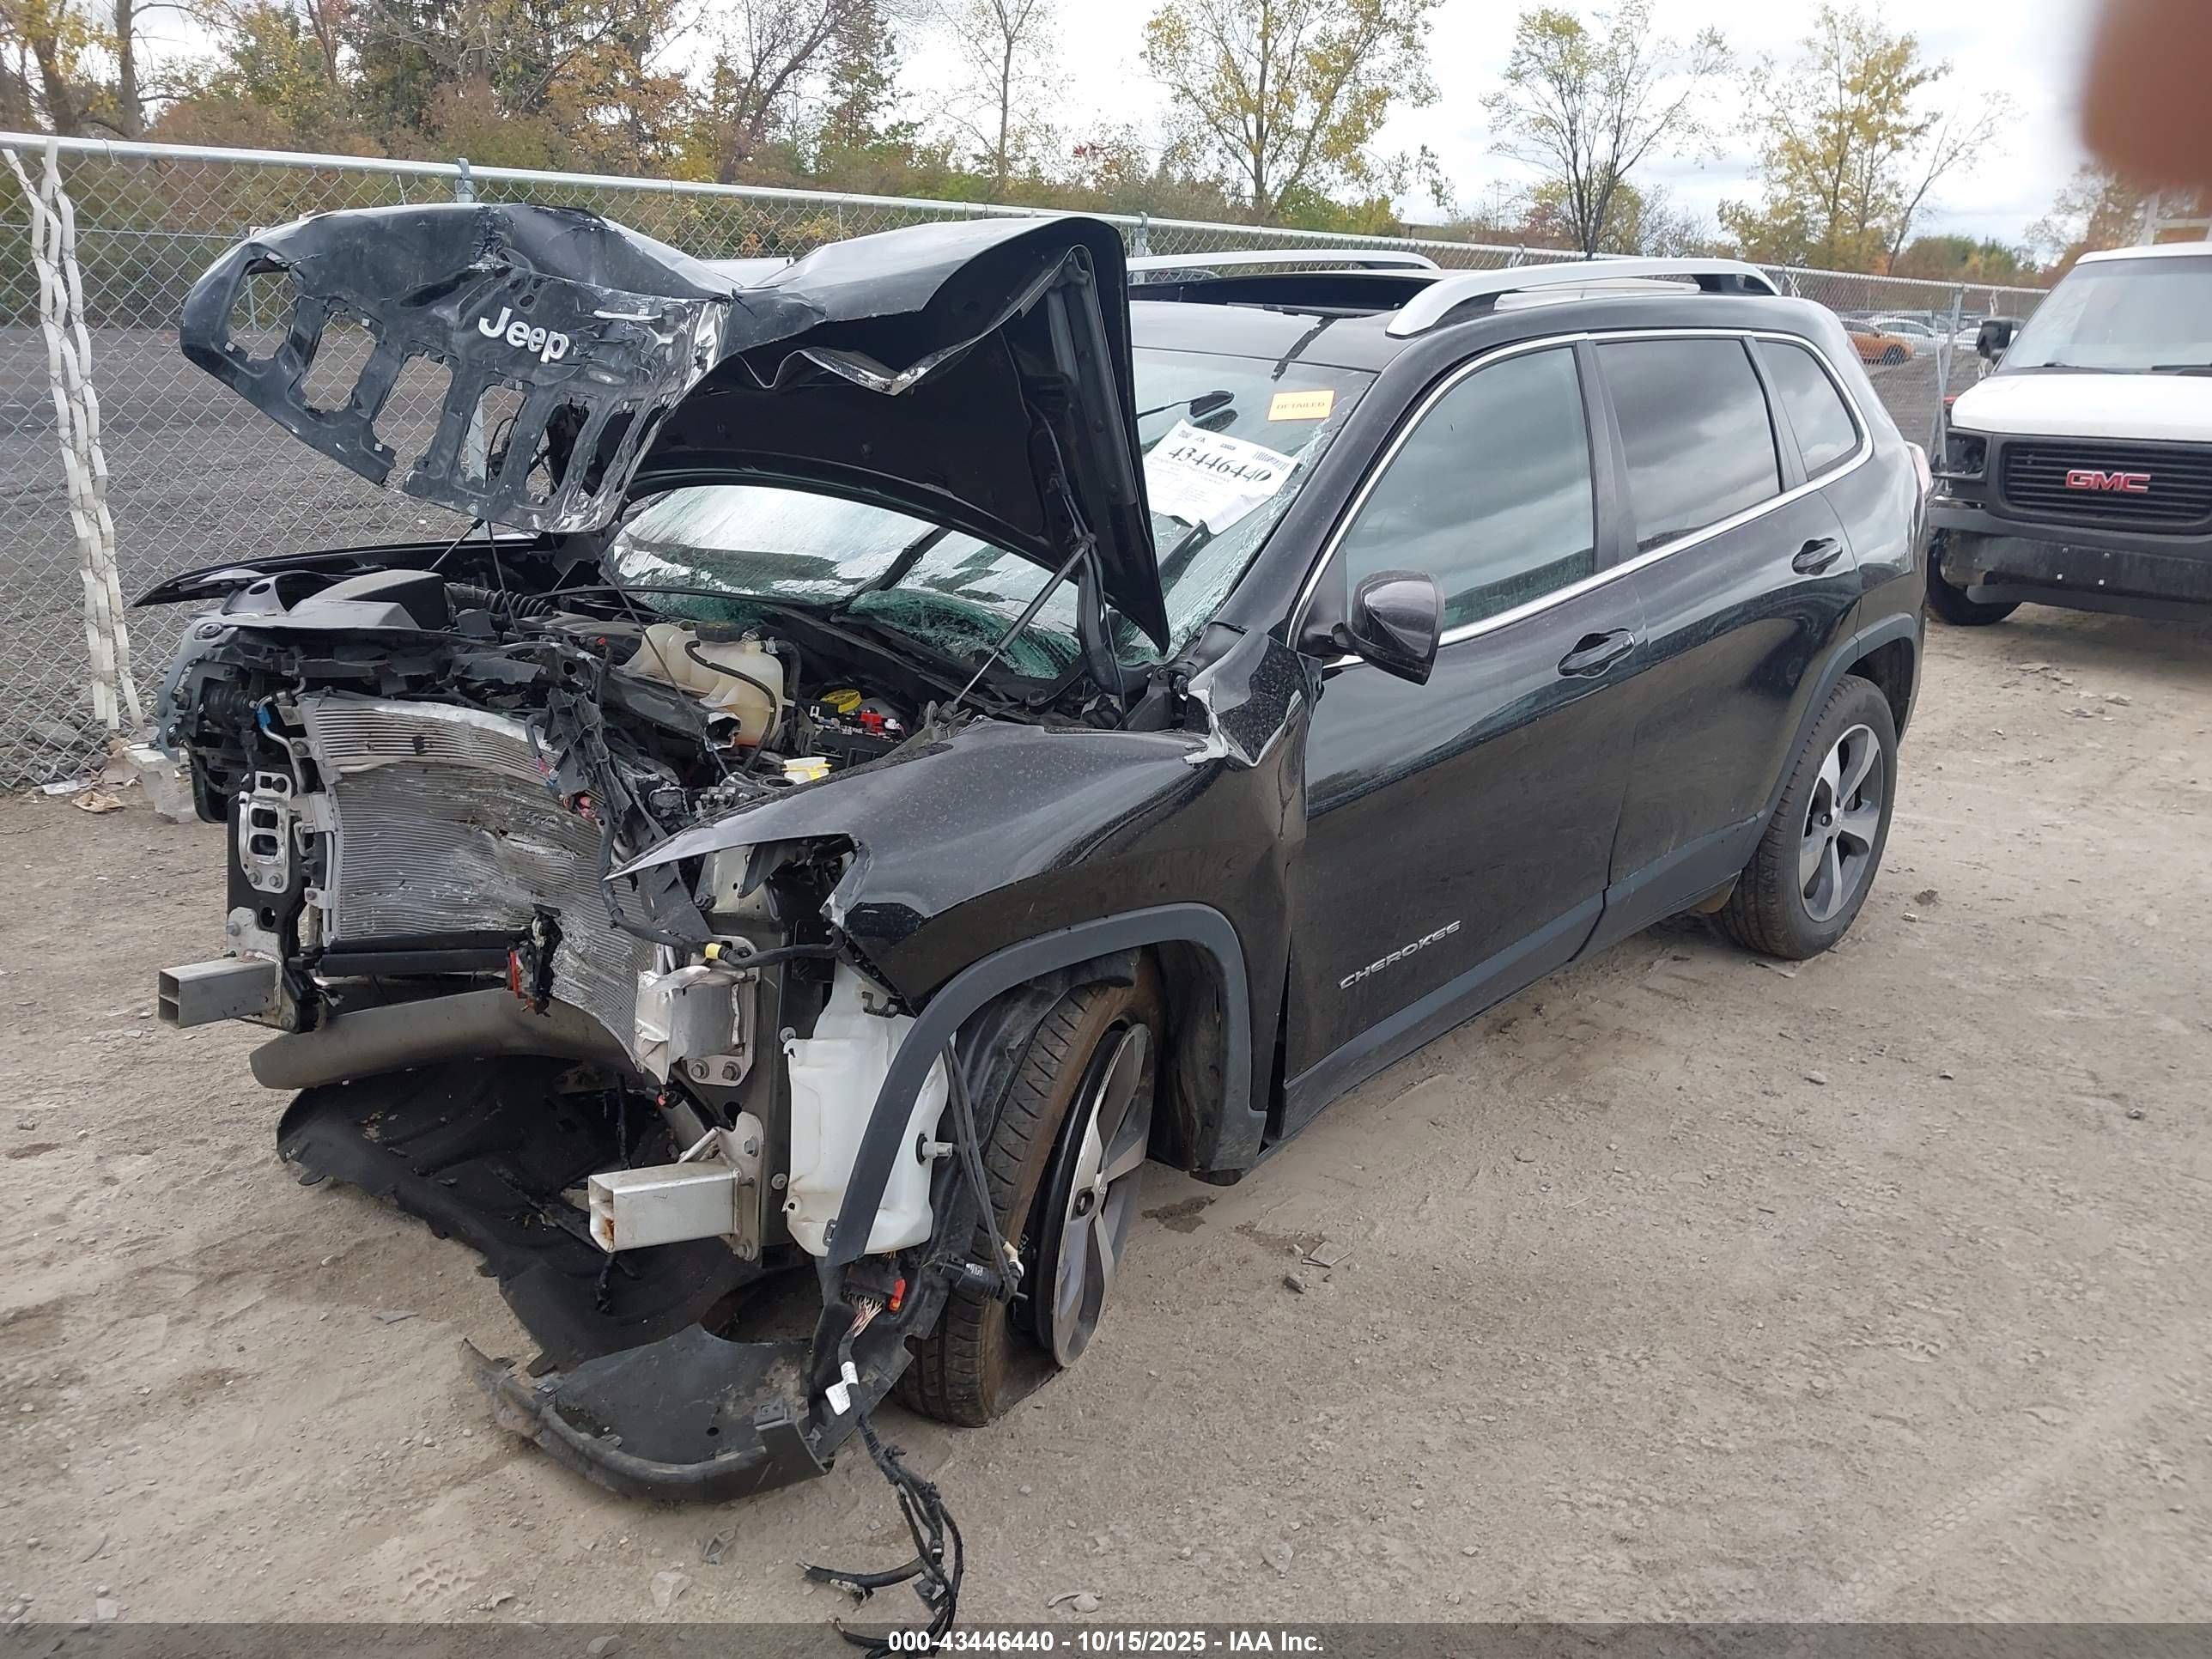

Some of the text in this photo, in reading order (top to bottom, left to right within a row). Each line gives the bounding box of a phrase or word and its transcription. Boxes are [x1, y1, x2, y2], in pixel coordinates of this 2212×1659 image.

[478, 307, 570, 363] Jeep
[1168, 446, 1273, 482] 43446440
[2065, 469, 2151, 493] GMC
[1339, 920, 1462, 989] CHEROKEE
